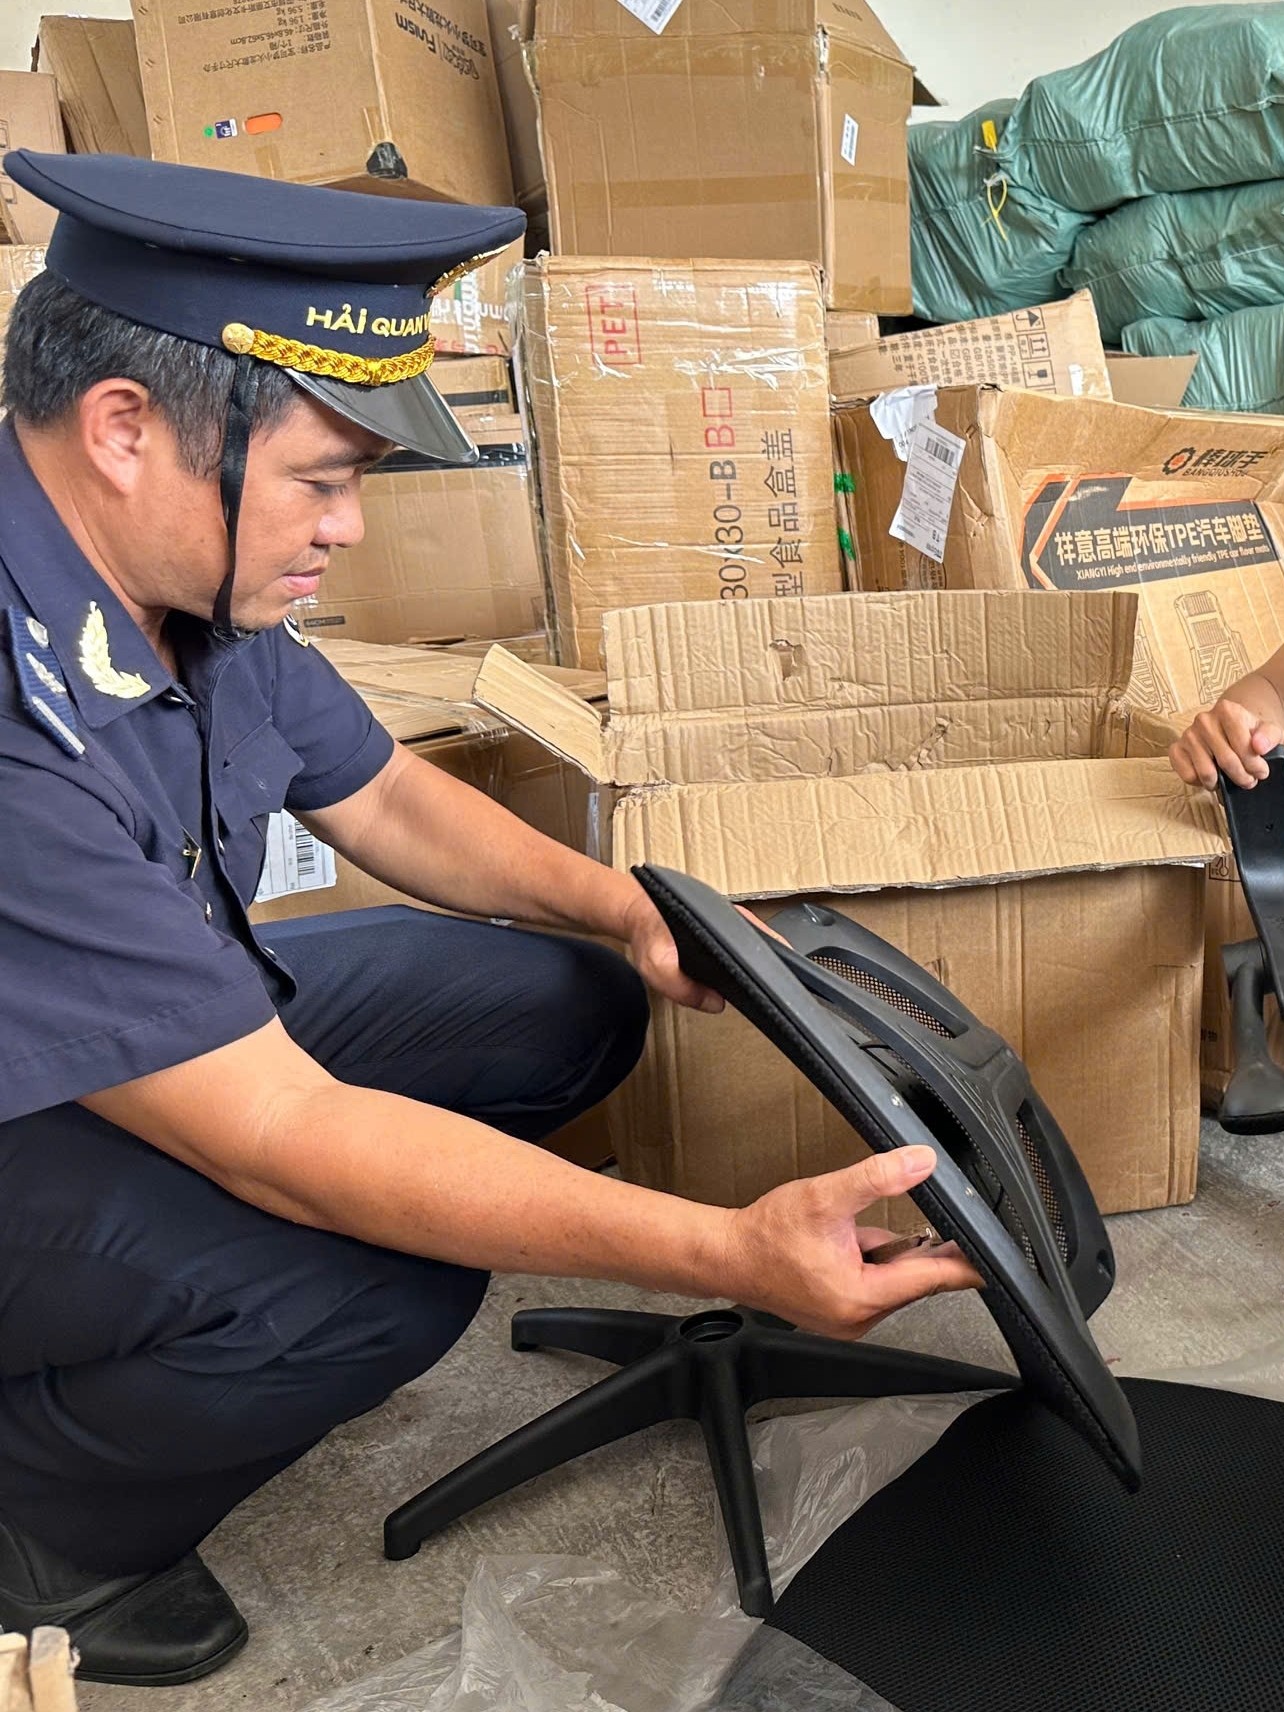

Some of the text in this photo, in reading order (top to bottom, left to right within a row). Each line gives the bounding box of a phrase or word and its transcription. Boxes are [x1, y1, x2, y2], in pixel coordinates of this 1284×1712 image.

[306, 303, 368, 334] HẢI
[371, 314, 425, 338] QUAN
[601, 294, 628, 357] PET
[1192, 448, 1268, 469] 棒球手
[1054, 512, 1265, 566] 祥意高端环保TPE汽车脚垫
[1107, 565, 1124, 578] High
[1124, 563, 1138, 573] end
[1192, 551, 1217, 563] friendly
[1217, 550, 1230, 559] TPE
